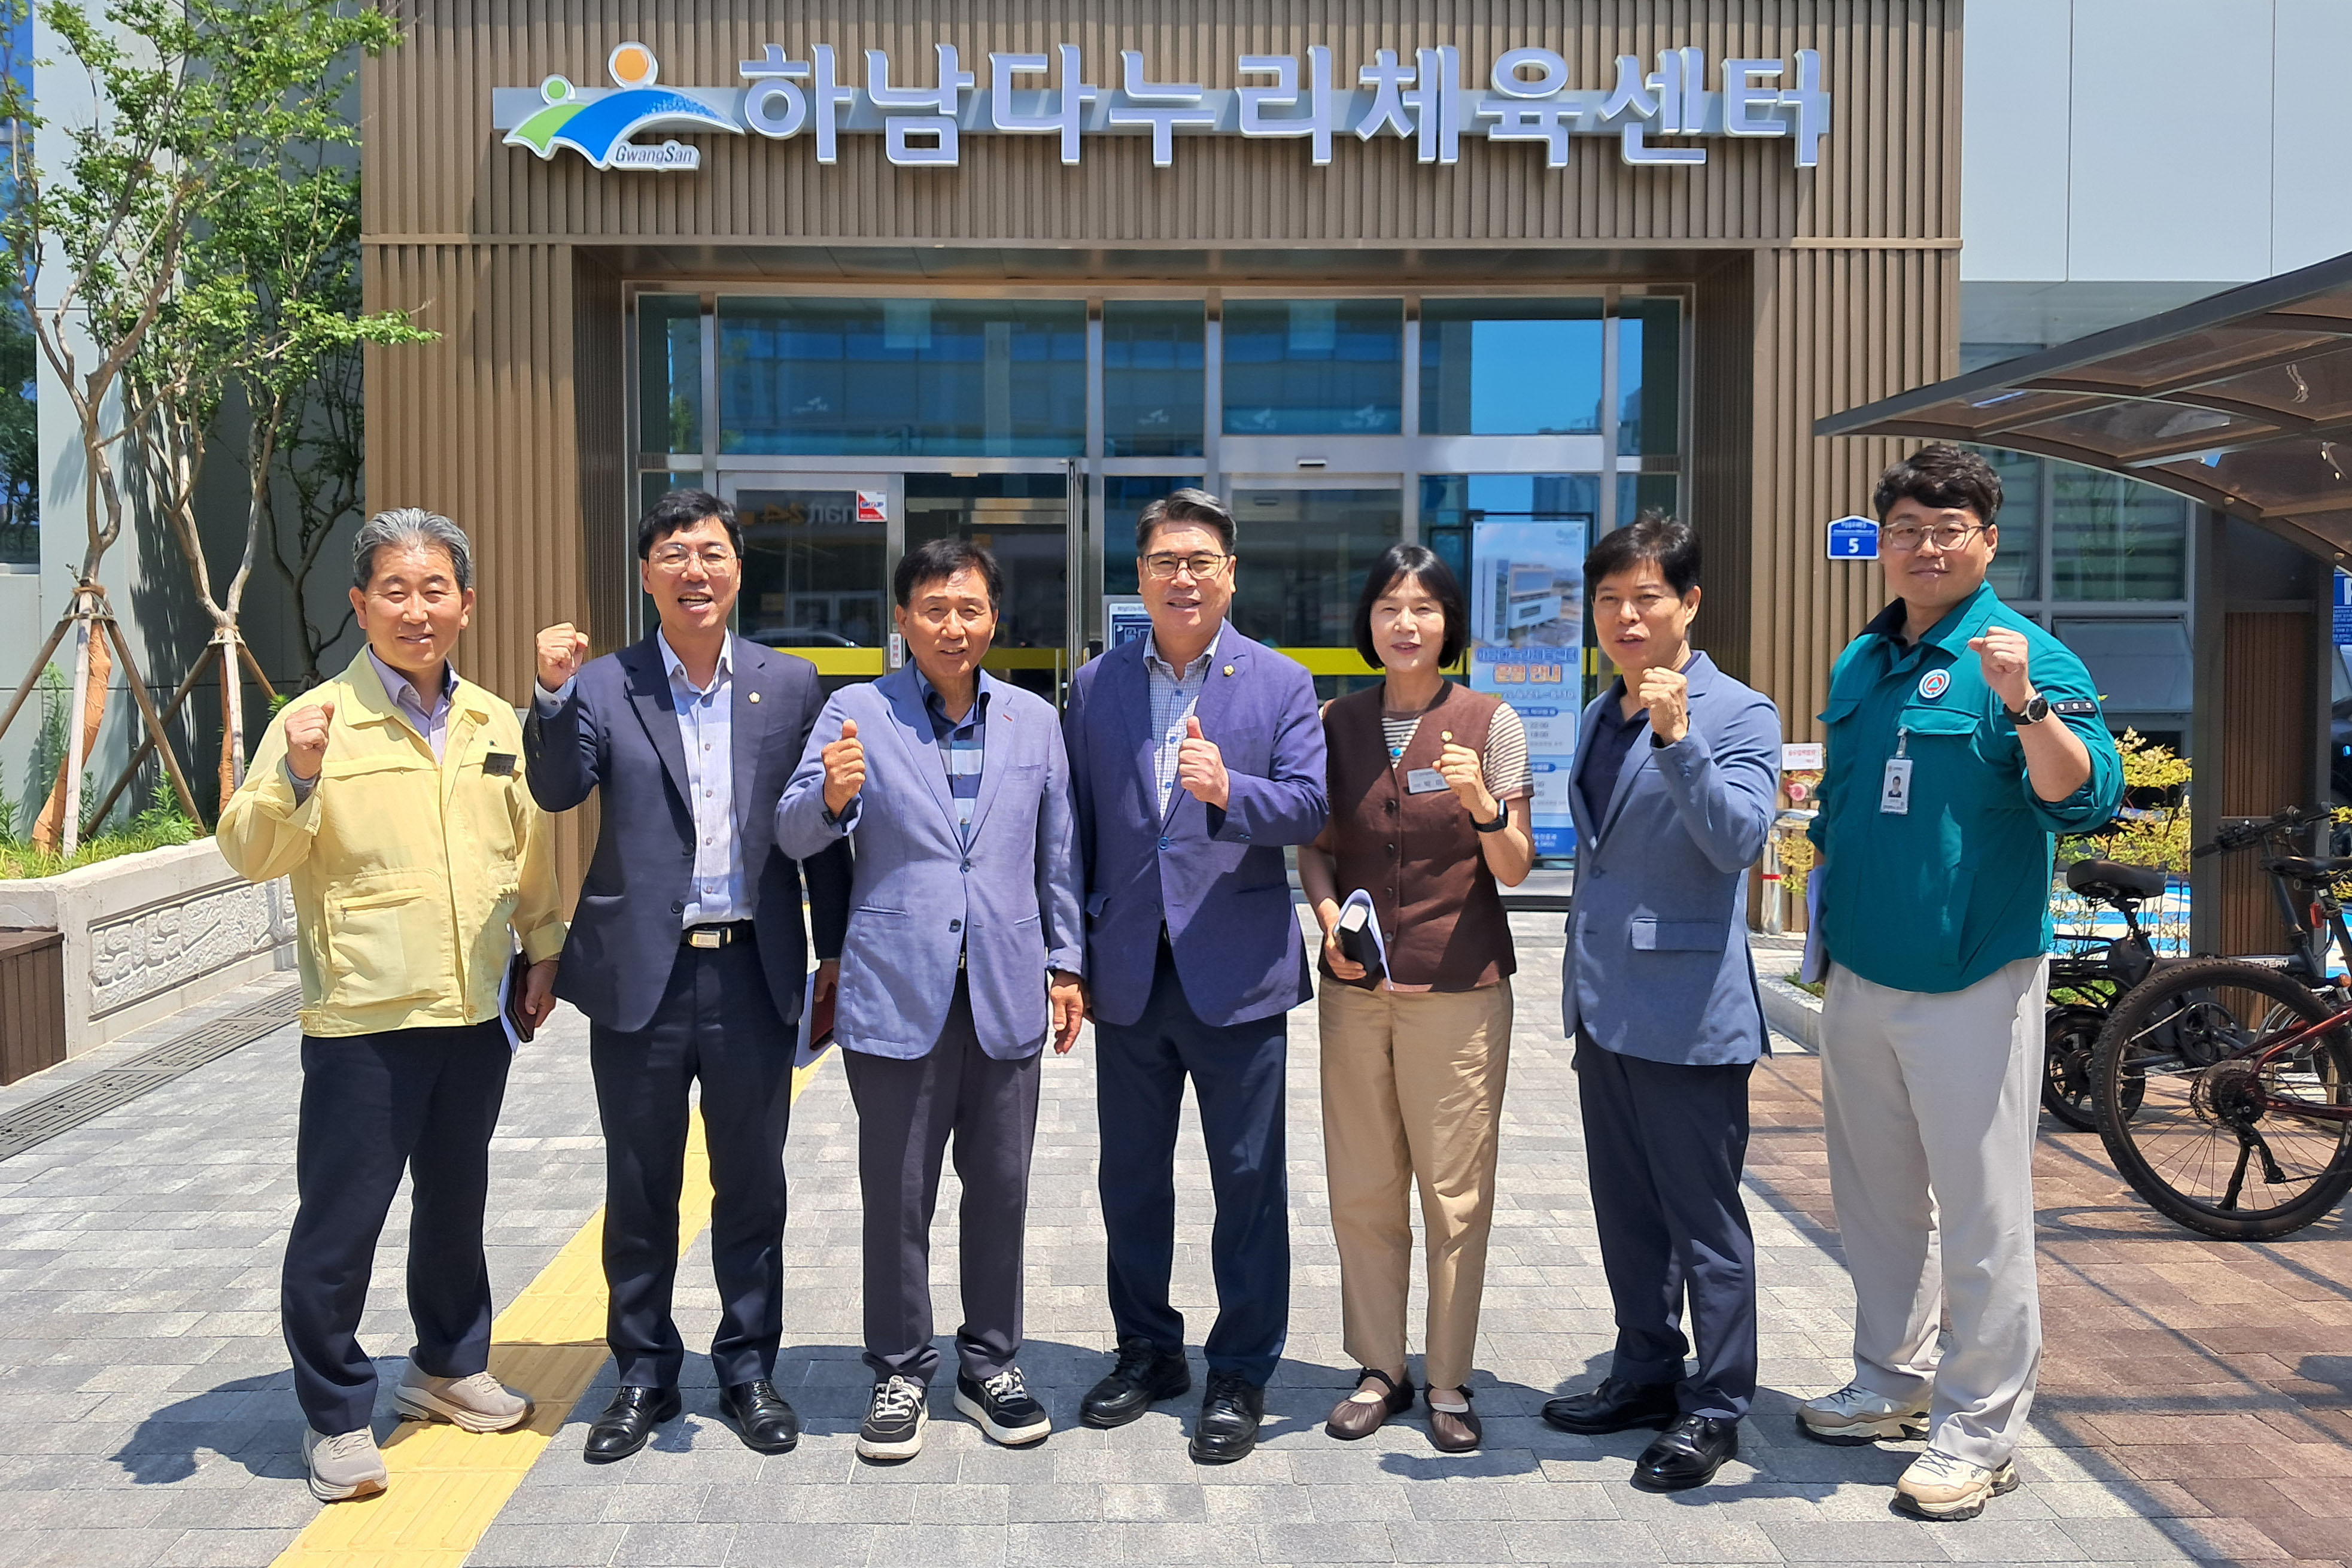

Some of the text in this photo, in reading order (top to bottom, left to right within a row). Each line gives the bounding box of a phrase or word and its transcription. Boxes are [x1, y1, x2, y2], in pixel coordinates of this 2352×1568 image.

[739, 43, 1821, 168] 하남다누리체육센터
[615, 145, 692, 163] GwangSan
[1848, 537, 1859, 554] 5
